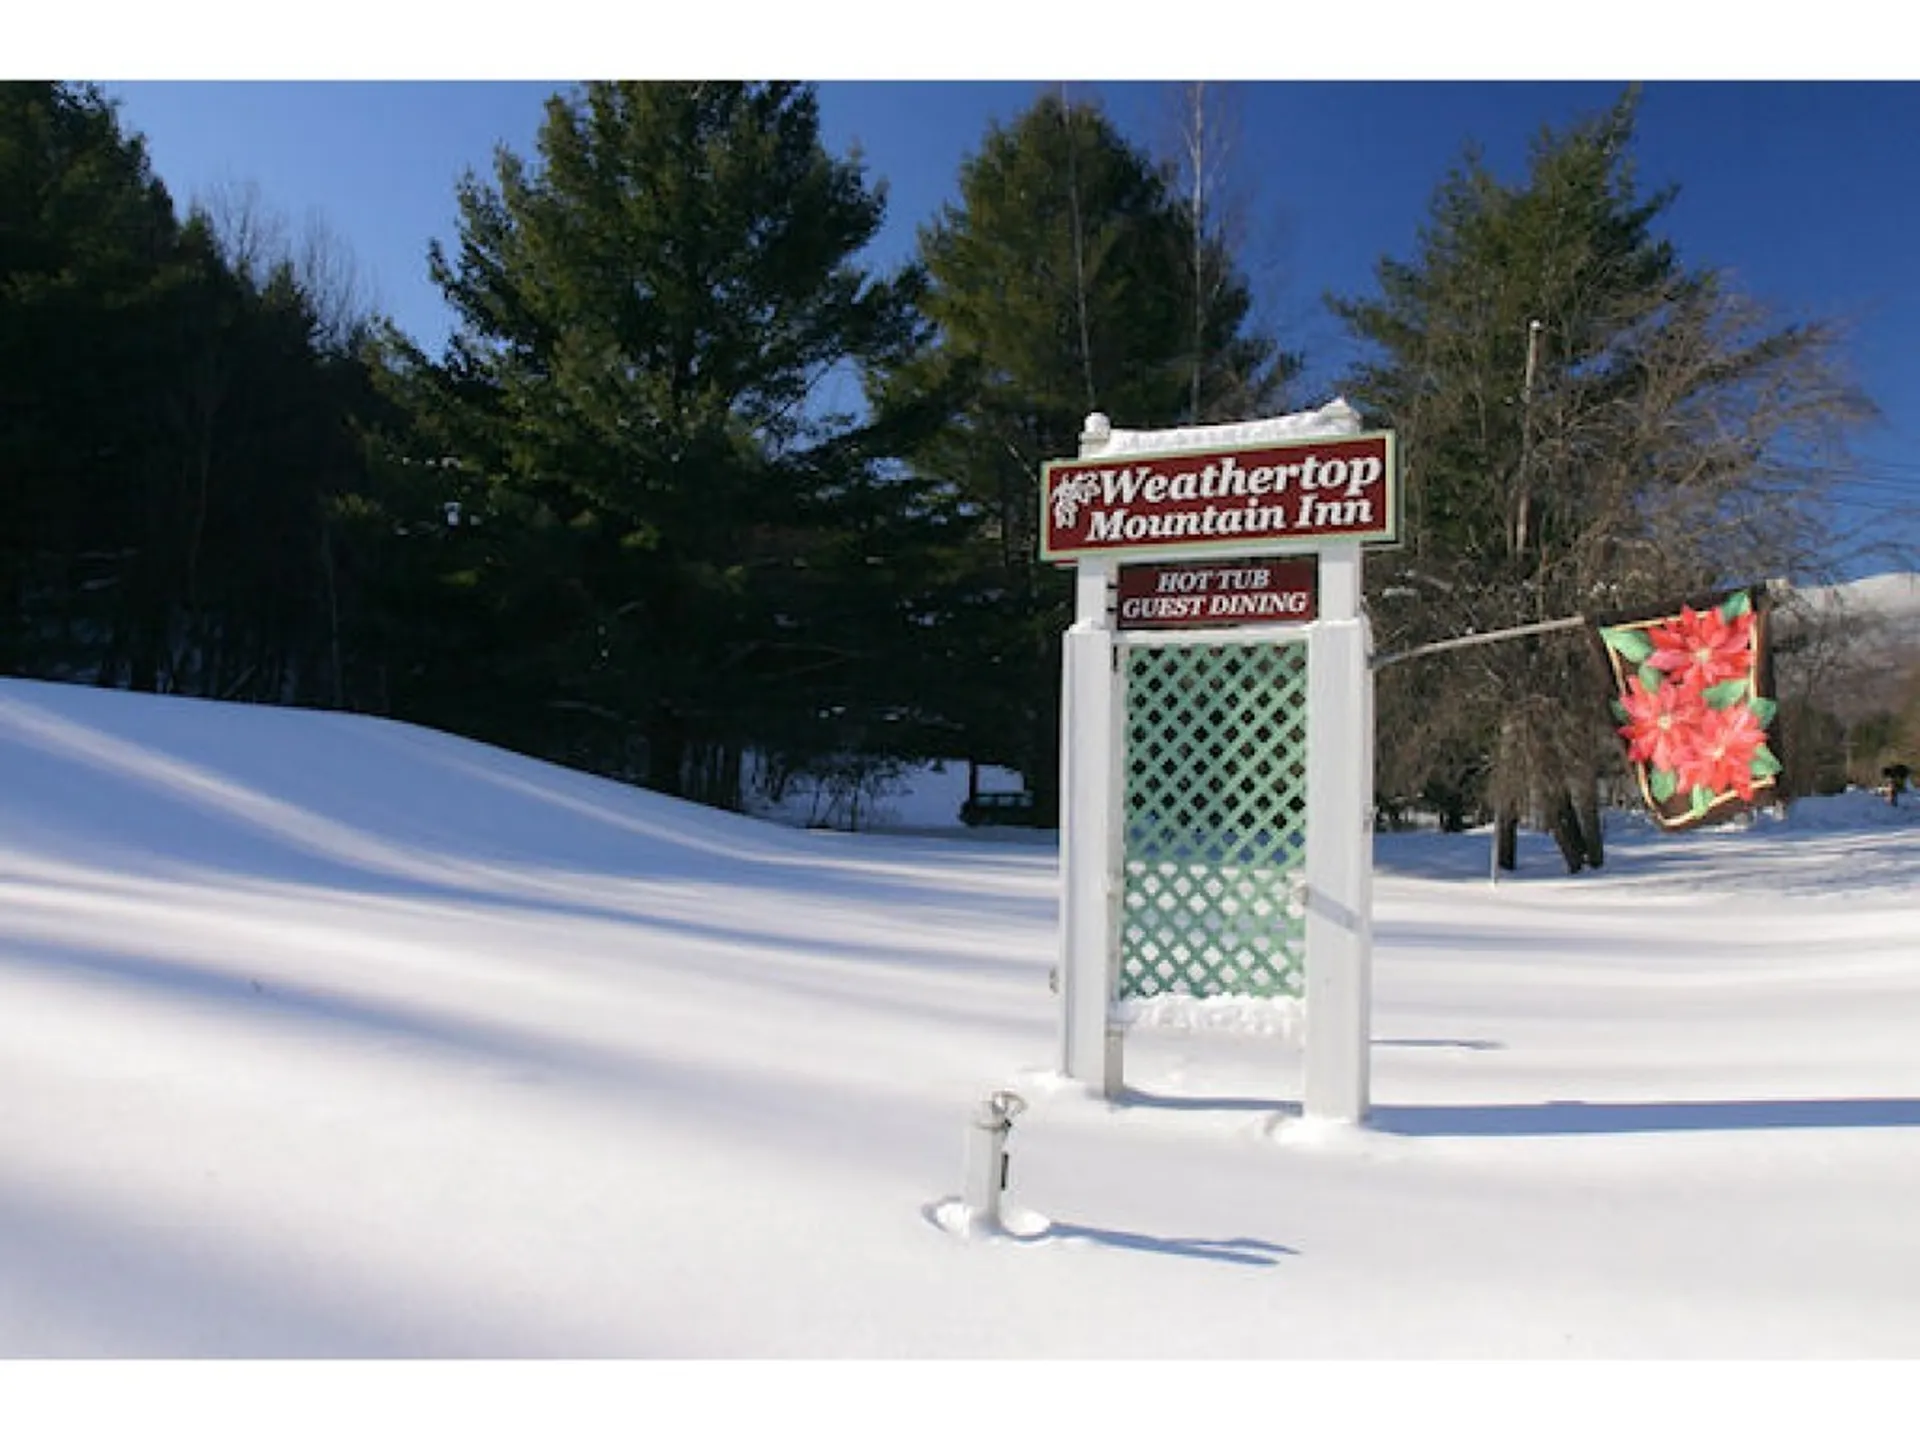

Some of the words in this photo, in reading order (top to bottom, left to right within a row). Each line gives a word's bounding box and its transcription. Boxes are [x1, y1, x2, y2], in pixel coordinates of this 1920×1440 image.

[1100, 456, 1382, 505] Weathertop
[1085, 498, 1286, 541] Mountain
[1294, 493, 1374, 529] Inn
[1157, 569, 1214, 592] HOT
[1218, 568, 1271, 590] TUB
[1122, 595, 1204, 619] GUEST
[1208, 591, 1307, 616] DINING
